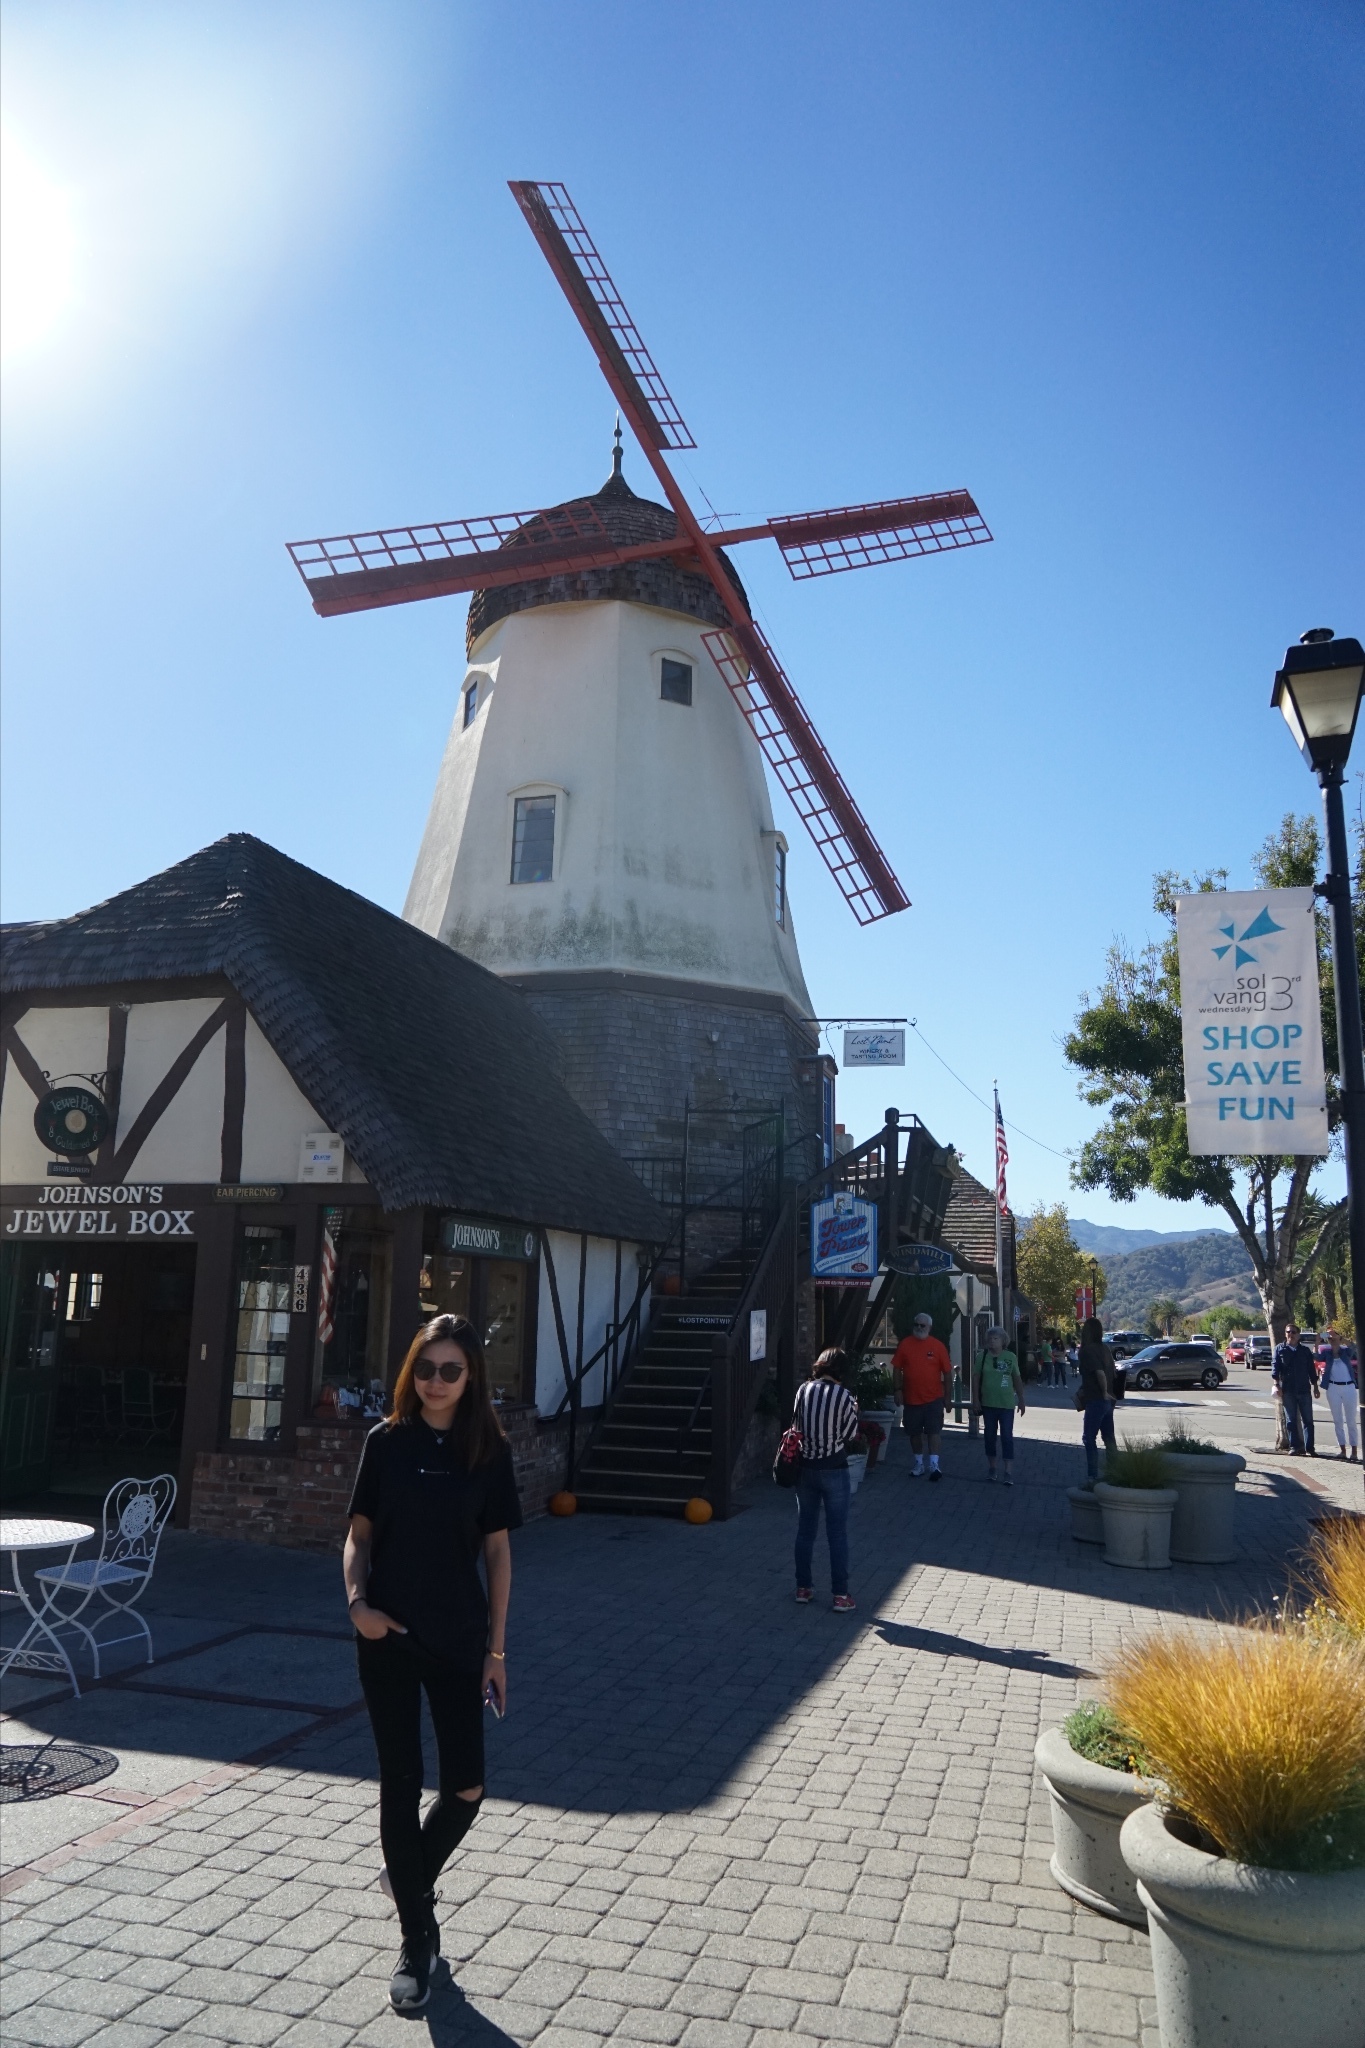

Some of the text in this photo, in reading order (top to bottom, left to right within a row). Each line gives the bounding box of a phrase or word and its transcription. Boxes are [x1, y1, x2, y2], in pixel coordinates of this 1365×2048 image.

[1236, 973, 1266, 990] sol
[1198, 1005, 1252, 1014] wednesday
[1213, 991, 1267, 1012] vang
[1202, 1024, 1303, 1051] SHOP
[1206, 1060, 1302, 1086] SAVE
[49, 1095, 100, 1121] Jewel Box
[1218, 1096, 1295, 1121] FUN
[53, 1165, 70, 1173] ESTATE
[38, 1186, 164, 1204] JOHNSON'S
[216, 1187, 277, 1198] EAR PIERCING
[6, 1209, 195, 1235] JEWEL BOX
[821, 1215, 866, 1238] Tower
[452, 1223, 500, 1250] JOHNSON'S
[819, 1234, 869, 1258] Pizza
[891, 1247, 945, 1262] WINDMILL
